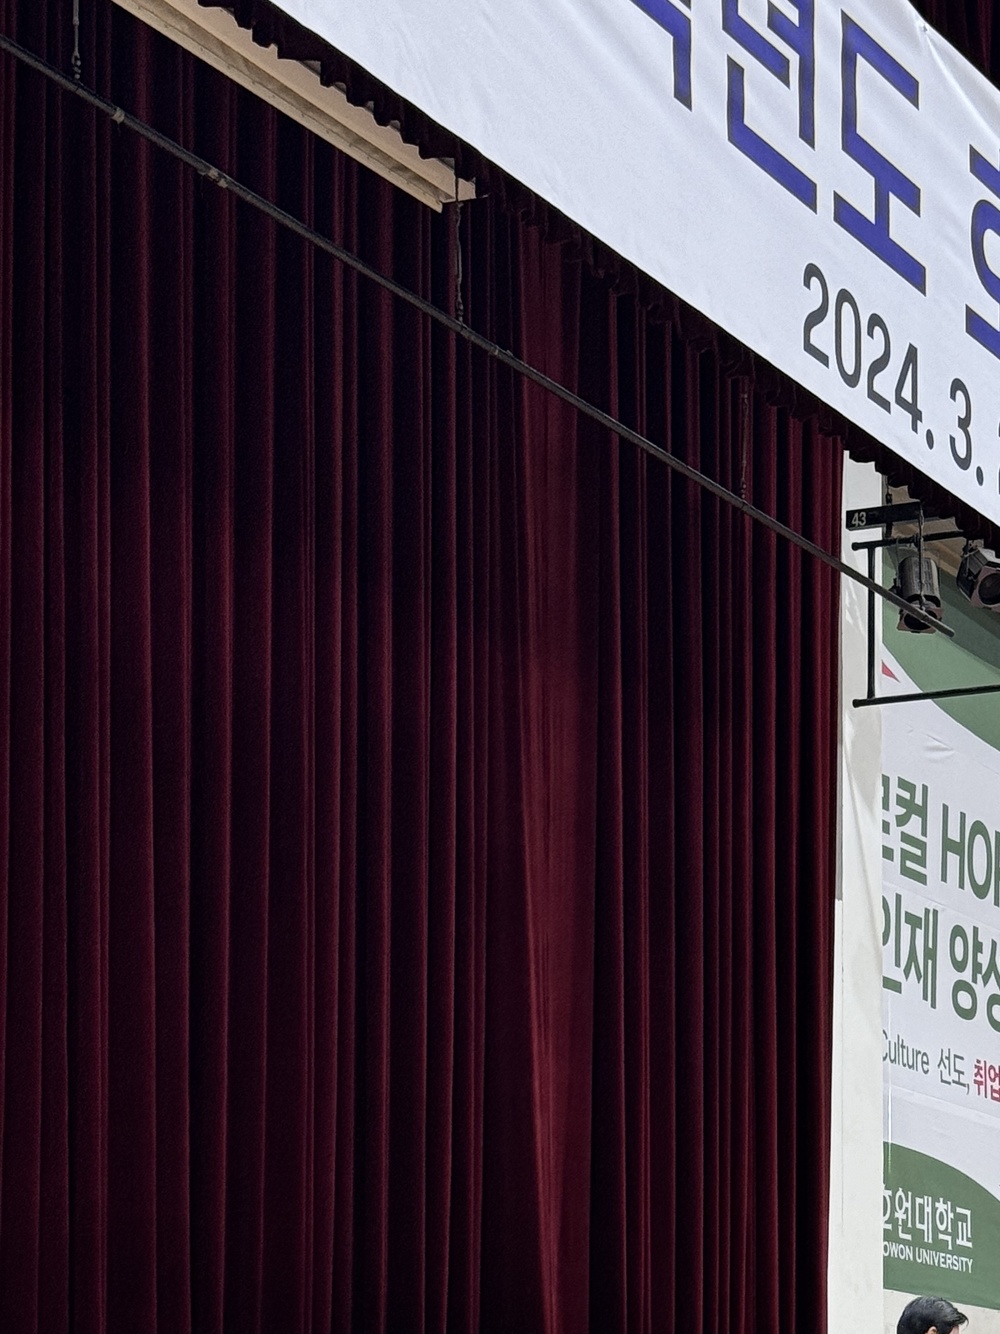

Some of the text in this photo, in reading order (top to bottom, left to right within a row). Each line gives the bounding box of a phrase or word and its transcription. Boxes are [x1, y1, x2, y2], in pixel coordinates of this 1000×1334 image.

[628, 0, 926, 297] 년도
[851, 511, 867, 527] 43
[937, 1048, 970, 1096] 선도,
[916, 1247, 973, 1274] UNIVERSITY
